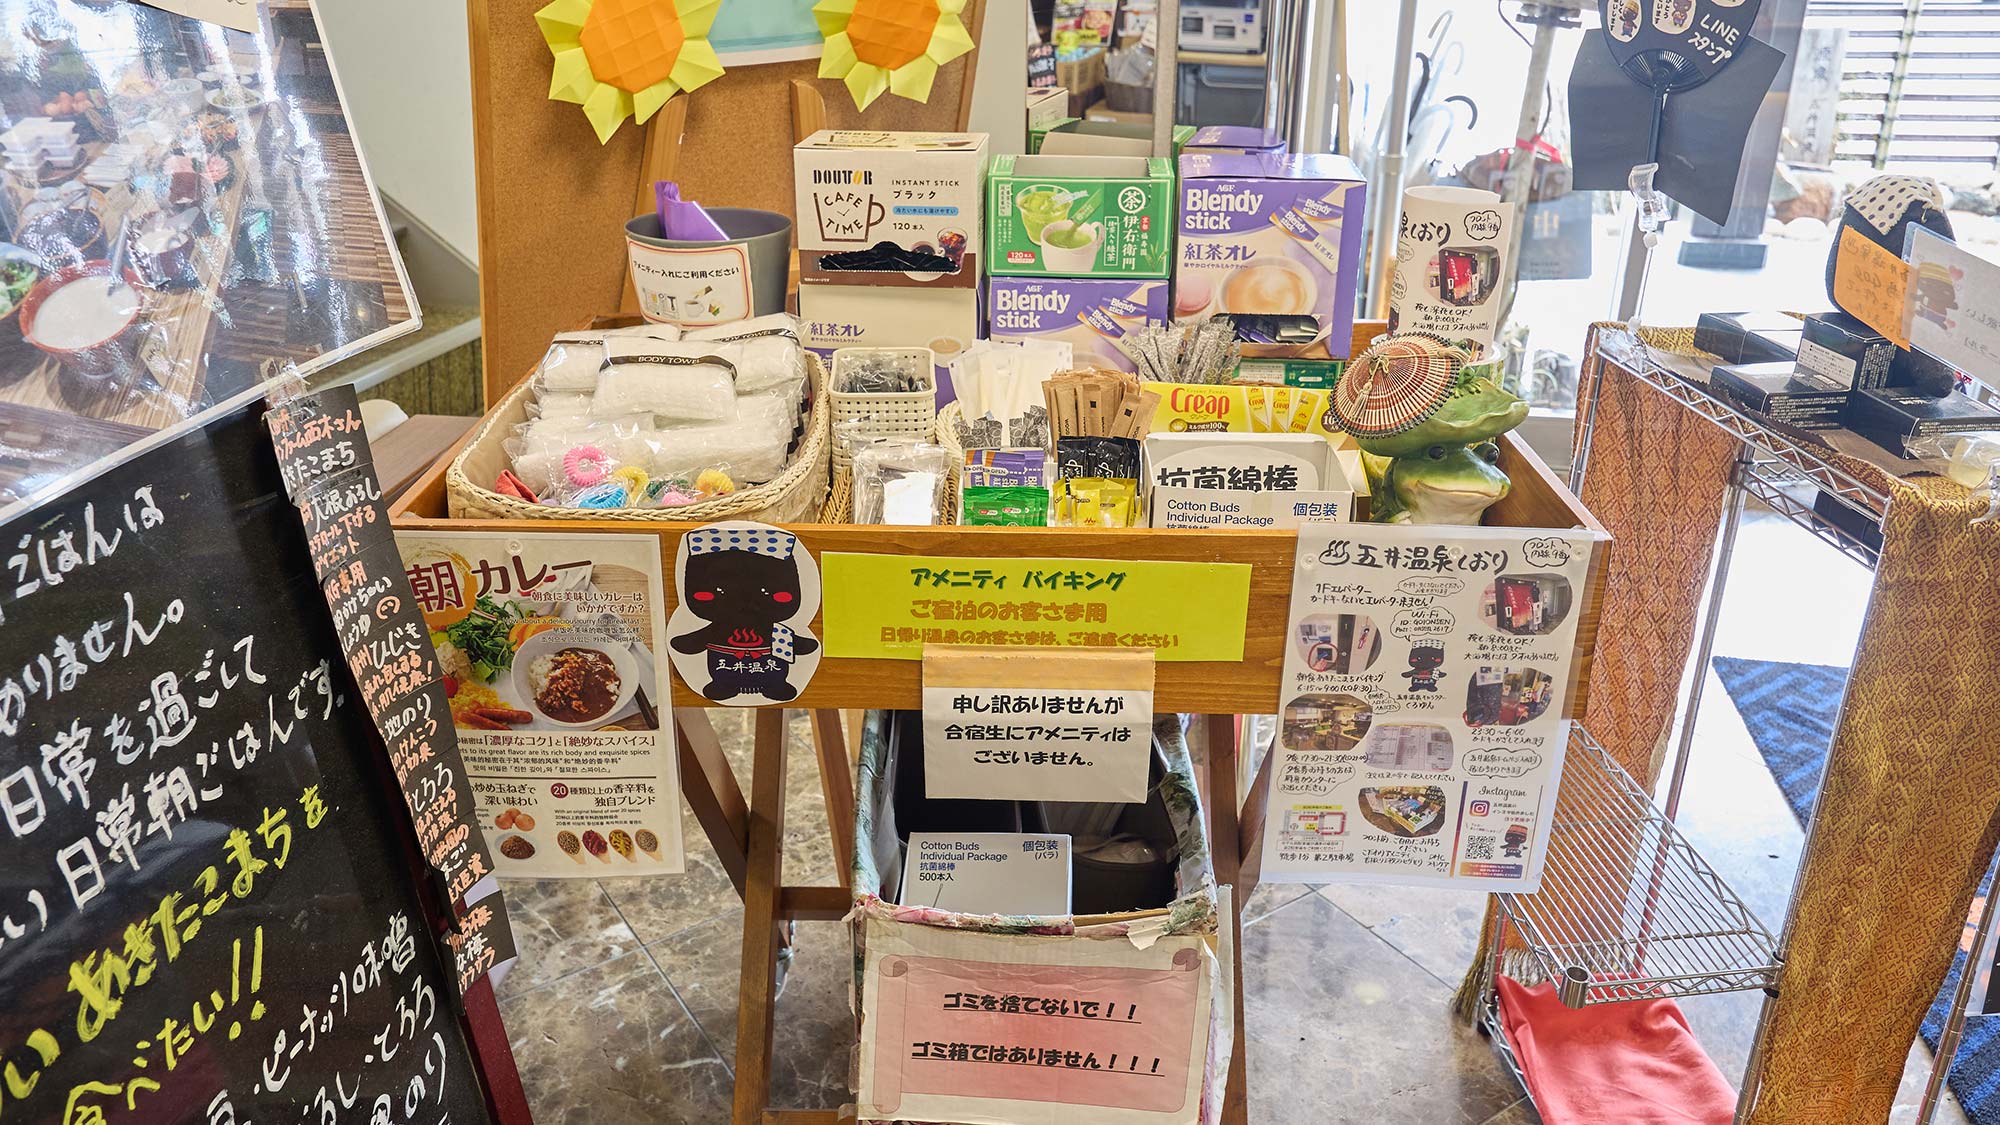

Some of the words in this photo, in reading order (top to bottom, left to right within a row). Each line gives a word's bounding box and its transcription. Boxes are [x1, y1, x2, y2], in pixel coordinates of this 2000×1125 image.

[1700, 13, 1740, 46] LINE
[1687, 31, 1732, 65] スタンプ
[813, 169, 873, 185] DOUTOR
[891, 179, 930, 187] INSTANT
[893, 190, 937, 200] ブラック
[1216, 184, 1236, 192] AGF
[823, 191, 864, 208] CAFE
[1122, 190, 1142, 209] 茶
[1186, 188, 1264, 215] Blendy
[1305, 198, 1332, 215] Blendy
[824, 218, 865, 235] TIME
[1185, 212, 1232, 230] stick
[1285, 211, 1308, 233] Blendy
[1122, 215, 1137, 270] 伊右衛門
[1184, 243, 1257, 261] 紅茶オレ
[1025, 285, 1043, 293] AGF
[996, 289, 1070, 314] Blendy
[1111, 297, 1137, 314] Blendy
[996, 312, 1041, 328] stick
[1091, 309, 1115, 331] Blendy
[810, 322, 865, 337] 紅茶オレ
[638, 356, 665, 364] BODY
[1171, 387, 1230, 419] Creap
[1273, 400, 1289, 410] Creap
[1167, 500, 1207, 511] Cotton
[1210, 502, 1240, 512] Buds
[1292, 502, 1338, 517] 個包装
[1167, 512, 1222, 523] Individual
[1224, 515, 1274, 526] Package
[7, 483, 165, 599] ごはんは
[1352, 543, 1509, 575] 五井温泉しおり
[406, 555, 592, 613] 朝カレー
[910, 567, 1008, 589] アメニティ
[1022, 570, 1128, 592] バイキング
[531, 591, 643, 602] 朝食に美味しいカレーは
[576, 604, 645, 614] いかがですか?
[909, 599, 1108, 624] ご宿泊のお客さま用
[1411, 609, 1439, 619] Wi-Fi
[368, 622, 422, 670] ひじき
[880, 626, 1179, 649] 日帰り温泉のお客さまは、ご遠慮ください
[715, 659, 782, 674] 五井温泉
[952, 693, 1124, 715] 申し訳ありませんが
[1, 634, 267, 838] 日常を過ごして
[943, 723, 1132, 744] 合宿生にアメニティは
[565, 749, 583, 757] body
[599, 749, 628, 757] exquisite
[630, 749, 651, 757] spices
[973, 747, 1099, 767] ございません。
[411, 762, 454, 812] とろろ
[553, 786, 567, 795] 20
[570, 783, 656, 795] 種類以上の香辛料を
[1478, 785, 1528, 801] Instagram
[0, 658, 345, 948] い日常朝ごはんです。
[485, 796, 538, 806] 深い味わい
[594, 796, 656, 807] 独自ブレンド
[920, 841, 952, 850] Cotton
[954, 841, 980, 851] Buds
[1022, 839, 1058, 852] 個包装
[920, 851, 965, 861] Individual
[967, 852, 1008, 862] Package
[1034, 850, 1059, 861] (バラ)
[919, 862, 956, 872] 抗菌綿棒
[919, 872, 954, 882] 500本入
[942, 991, 1138, 1021] ゴミを捨てないで！！
[911, 1040, 1162, 1074] ゴミ箱ではありません！！！
